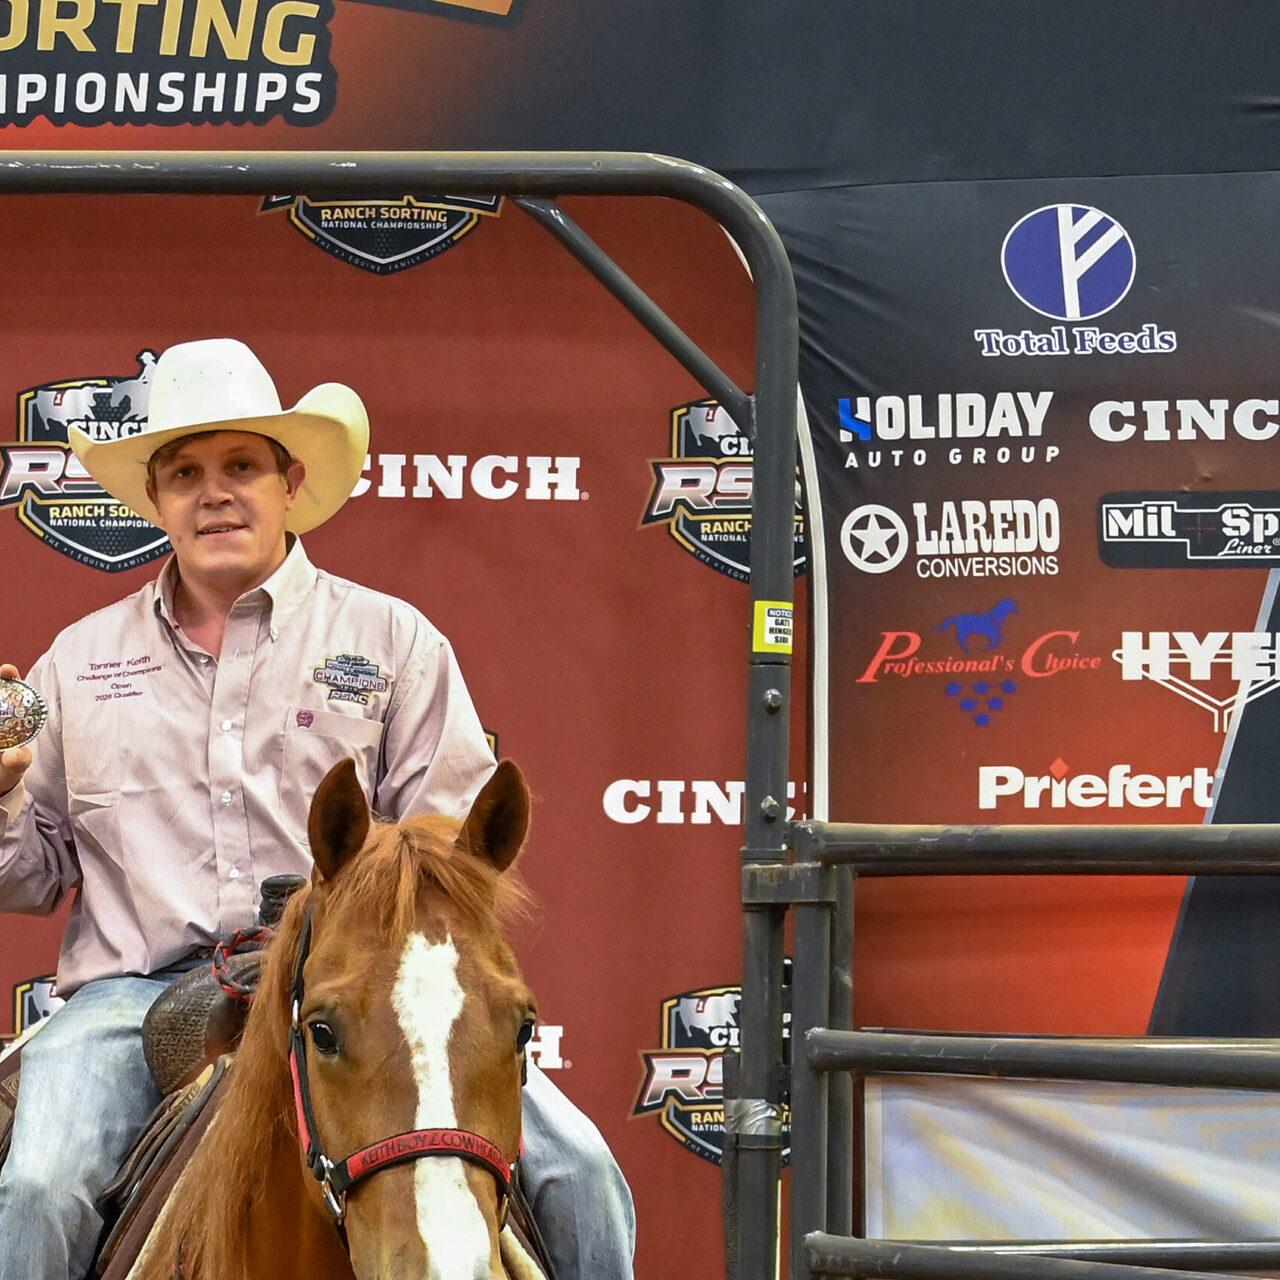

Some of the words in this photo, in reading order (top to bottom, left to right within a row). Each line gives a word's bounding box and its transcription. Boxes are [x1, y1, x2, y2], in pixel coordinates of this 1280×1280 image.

[321, 207, 376, 220] RANCH
[380, 207, 448, 222] SORTING
[321, 220, 368, 229] NATIONAL
[371, 221, 448, 230] CHAMPIONSHIPS
[974, 326, 1069, 358] Total
[1074, 323, 1177, 355] Feeds
[838, 391, 1055, 443] HOLIDAY
[1088, 398, 1280, 442] CINC
[844, 449, 928, 469] AUTO
[948, 445, 1060, 465] GROUP
[0, 450, 106, 500] RS
[49, 505, 105, 518] RANCH
[49, 518, 97, 528] NATIONAL
[912, 497, 1061, 556] LAREDO
[1107, 505, 1176, 538] Mil
[1221, 508, 1280, 544] Sp
[701, 534, 747, 543] NATIONAL
[1217, 537, 1272, 558] Liner
[916, 555, 1060, 579] CONVERSIONS
[88, 661, 122, 671] Tanner
[126, 655, 151, 667] Keith
[855, 630, 1016, 684] Professional's
[1021, 630, 1103, 679] Choice
[1121, 631, 1280, 681] HYE
[76, 673, 113, 681] Challenge
[122, 665, 162, 678] Champions
[316, 671, 386, 691] CHAMPIONS
[110, 682, 132, 690] Open
[330, 690, 369, 705] RSNC
[978, 757, 1214, 809] Priefert
[602, 777, 750, 826] CIN
[691, 1111, 725, 1123] RAN
[361, 1141, 396, 1166] KEITH
